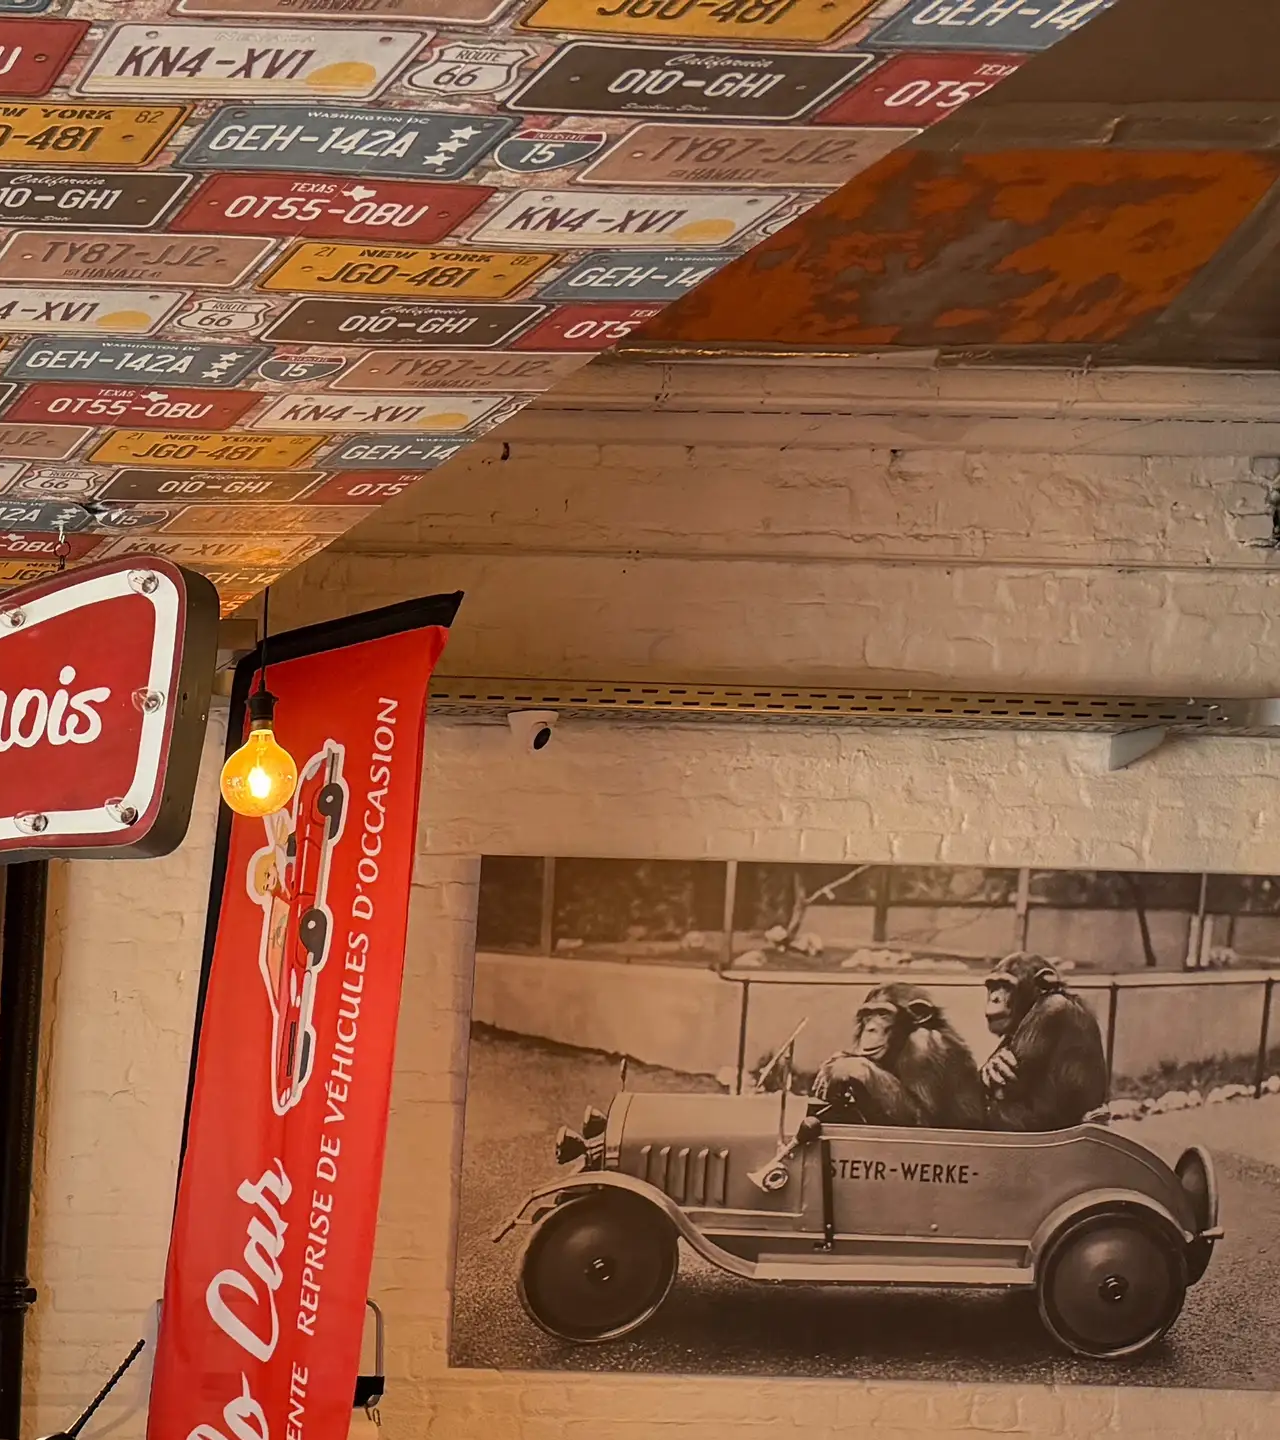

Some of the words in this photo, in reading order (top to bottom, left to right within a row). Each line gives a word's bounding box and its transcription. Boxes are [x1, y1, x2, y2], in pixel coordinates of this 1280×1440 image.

[456, 49, 500, 61] ROUTE
[664, 53, 773, 69] California
[430, 71, 477, 91] 66
[42, 108, 114, 119] YORK
[134, 111, 163, 125] 82
[307, 112, 403, 125] WASHINGTON
[207, 123, 419, 159] GEH-142A
[519, 143, 565, 163] 15
[9, 174, 105, 186] California
[291, 183, 342, 195] TEXAS
[198, 312, 234, 327] 66
[356, 697, 400, 925] D'OCCASION
[323, 932, 371, 1125] VÉHICULES
[314, 1133, 345, 1186] DE
[204, 1156, 295, 1366] Car
[295, 1190, 338, 1338] REPRISE
